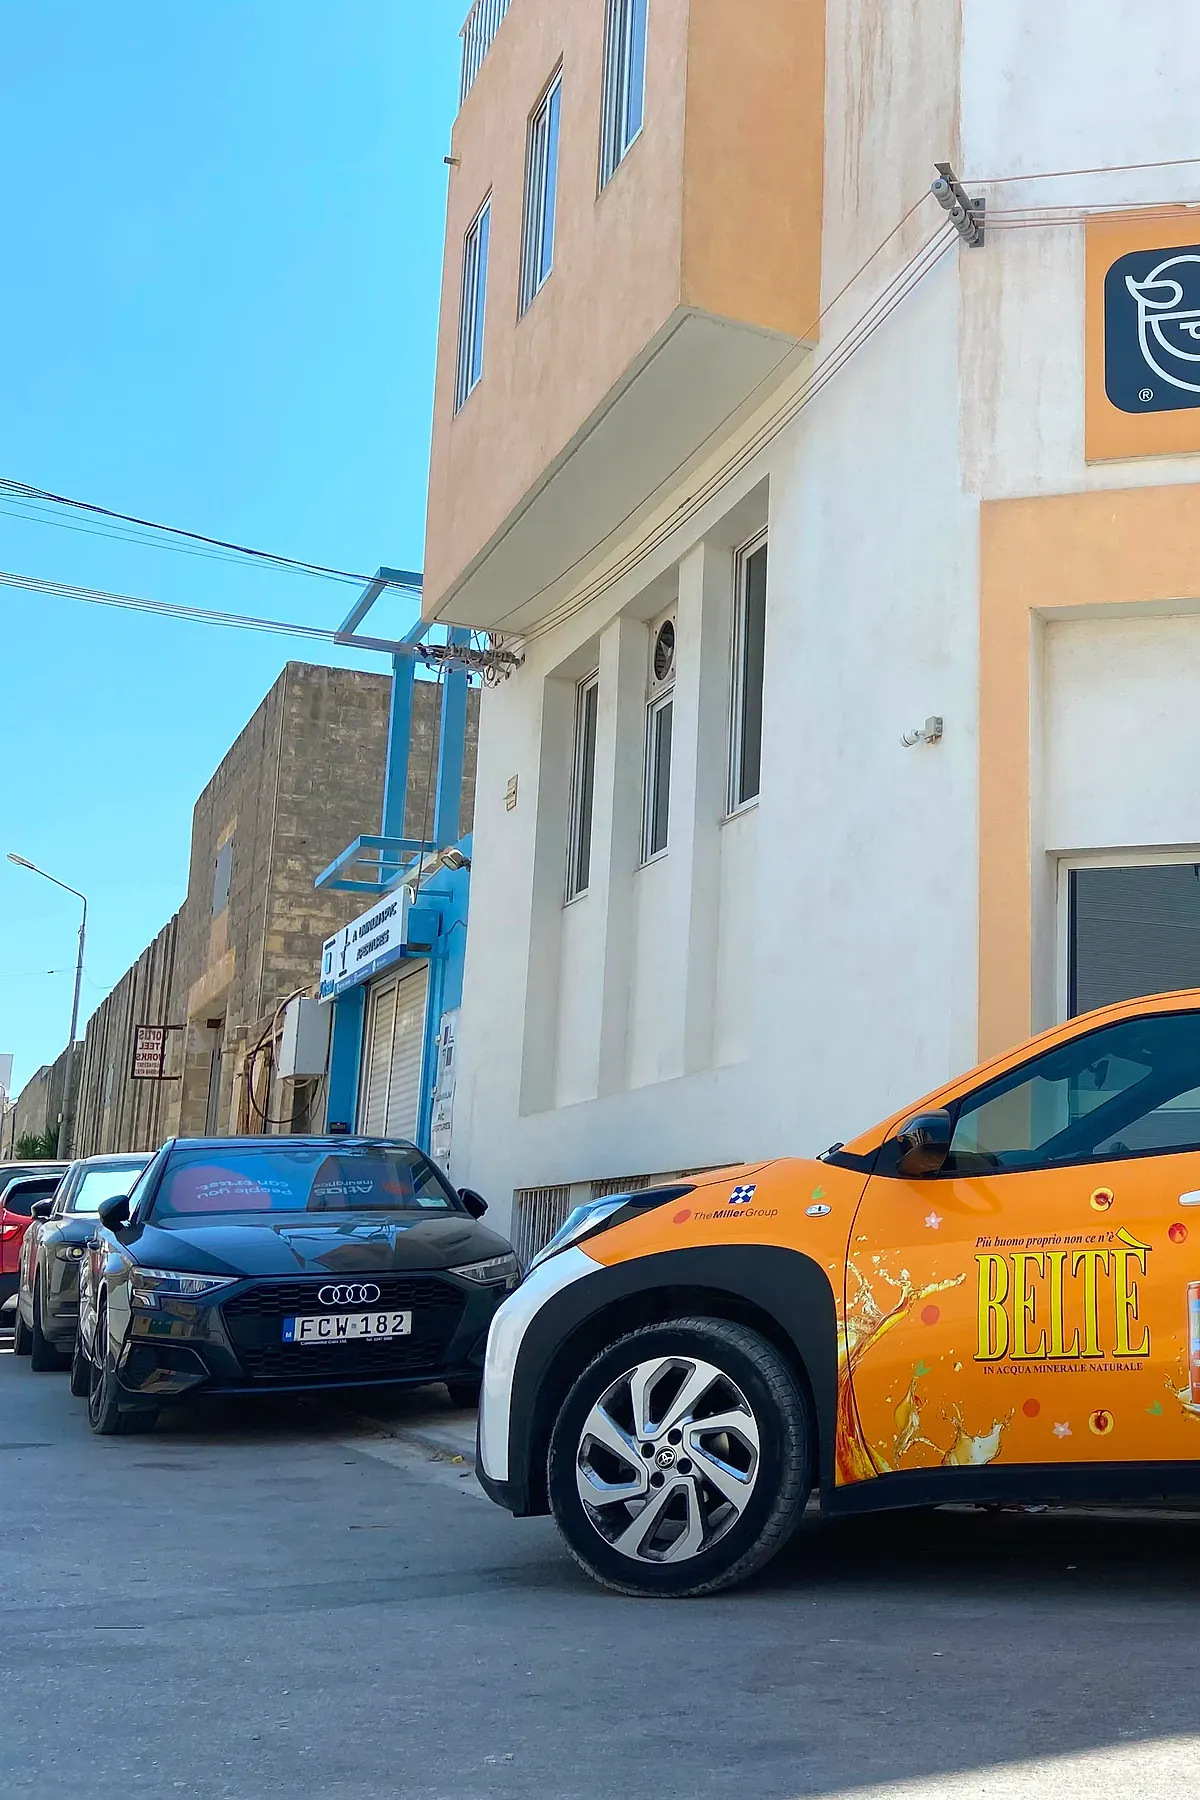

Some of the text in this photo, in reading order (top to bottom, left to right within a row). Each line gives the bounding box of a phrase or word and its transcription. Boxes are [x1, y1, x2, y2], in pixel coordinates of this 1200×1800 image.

[257, 1180, 289, 1188] can
[313, 1185, 373, 1196] Atlas
[197, 1186, 293, 1199] People you
[975, 1236, 992, 1247] Più
[994, 1235, 1024, 1247] buono
[1025, 1233, 1061, 1249] proprio
[1064, 1235, 1083, 1244] non
[1085, 1235, 1096, 1243] ce
[973, 1227, 1152, 1361] BELTÈ
[300, 1317, 349, 1338] FCW
[360, 1314, 404, 1335] 182
[984, 1362, 1143, 1375] IN ACQUA MINERALE NATURALE
